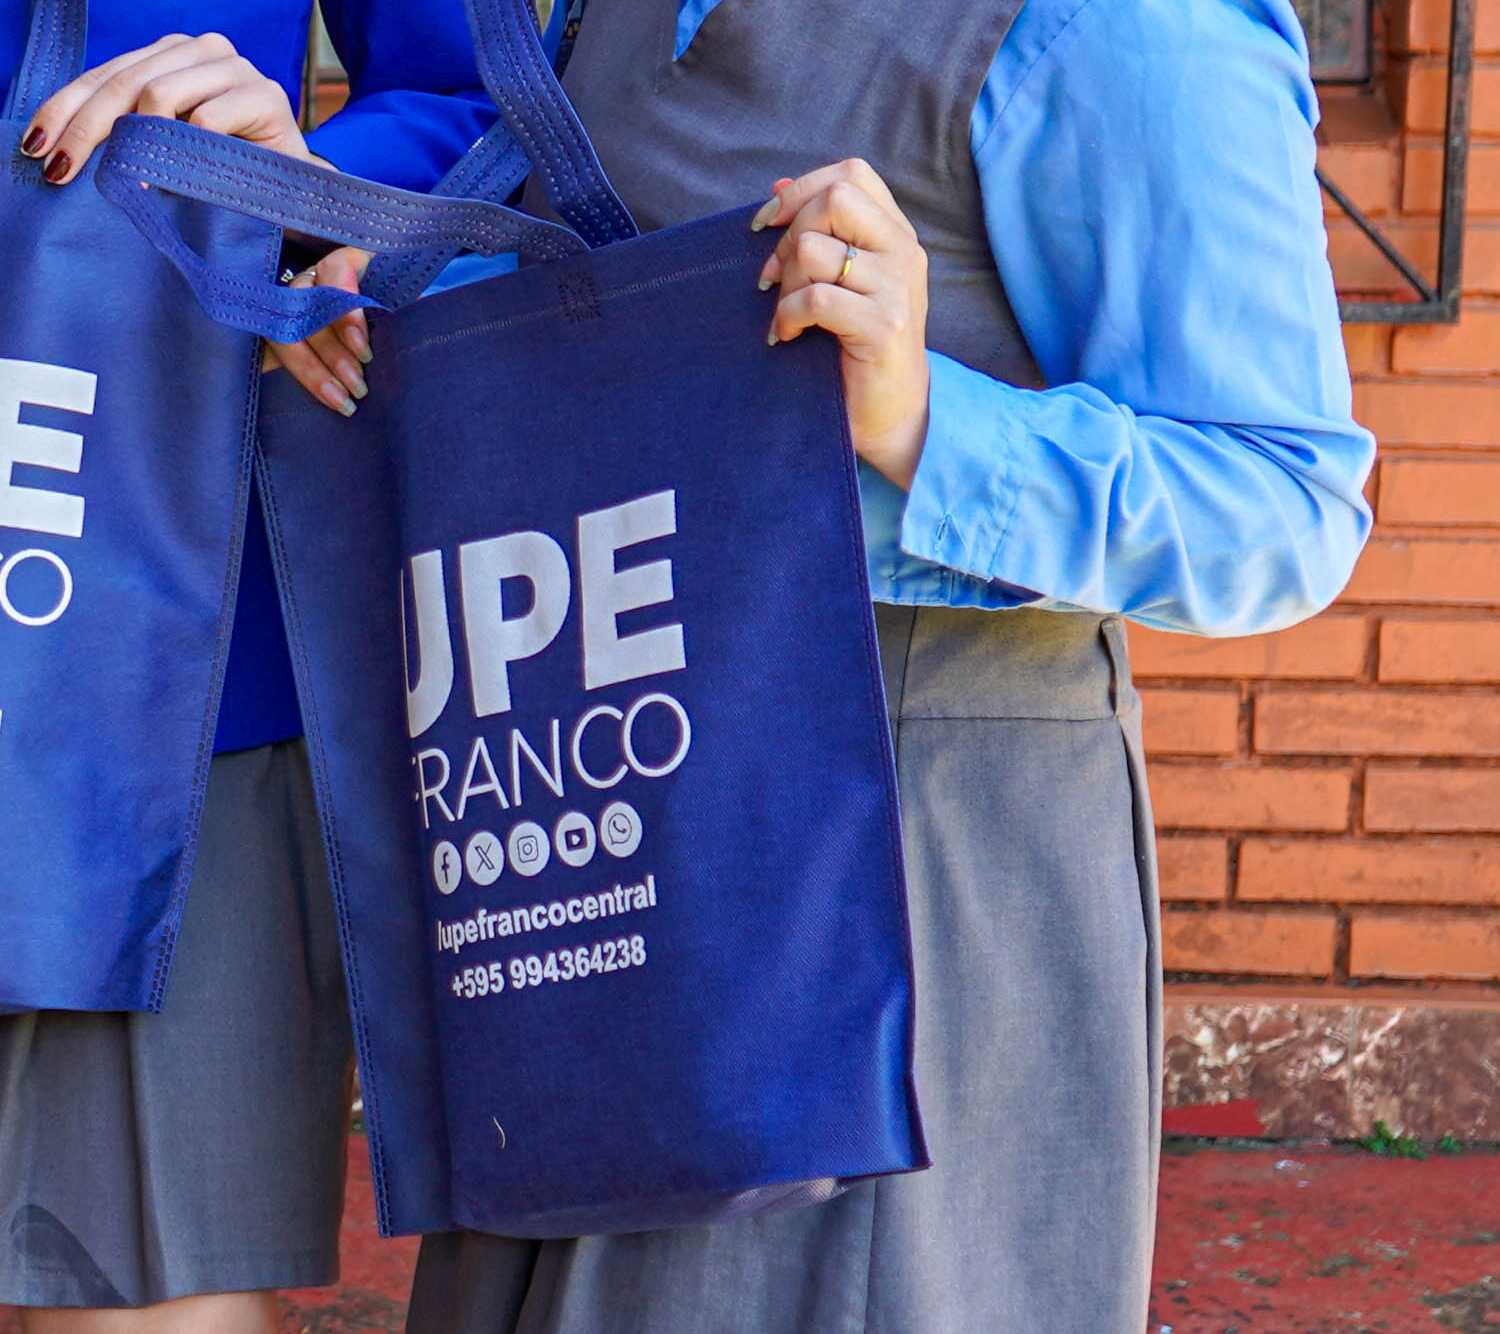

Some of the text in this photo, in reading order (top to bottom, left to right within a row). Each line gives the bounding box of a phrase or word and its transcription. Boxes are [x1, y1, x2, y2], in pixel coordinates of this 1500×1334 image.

[412, 693, 691, 829] RANCO
[452, 935, 647, 999] +595 994364238
